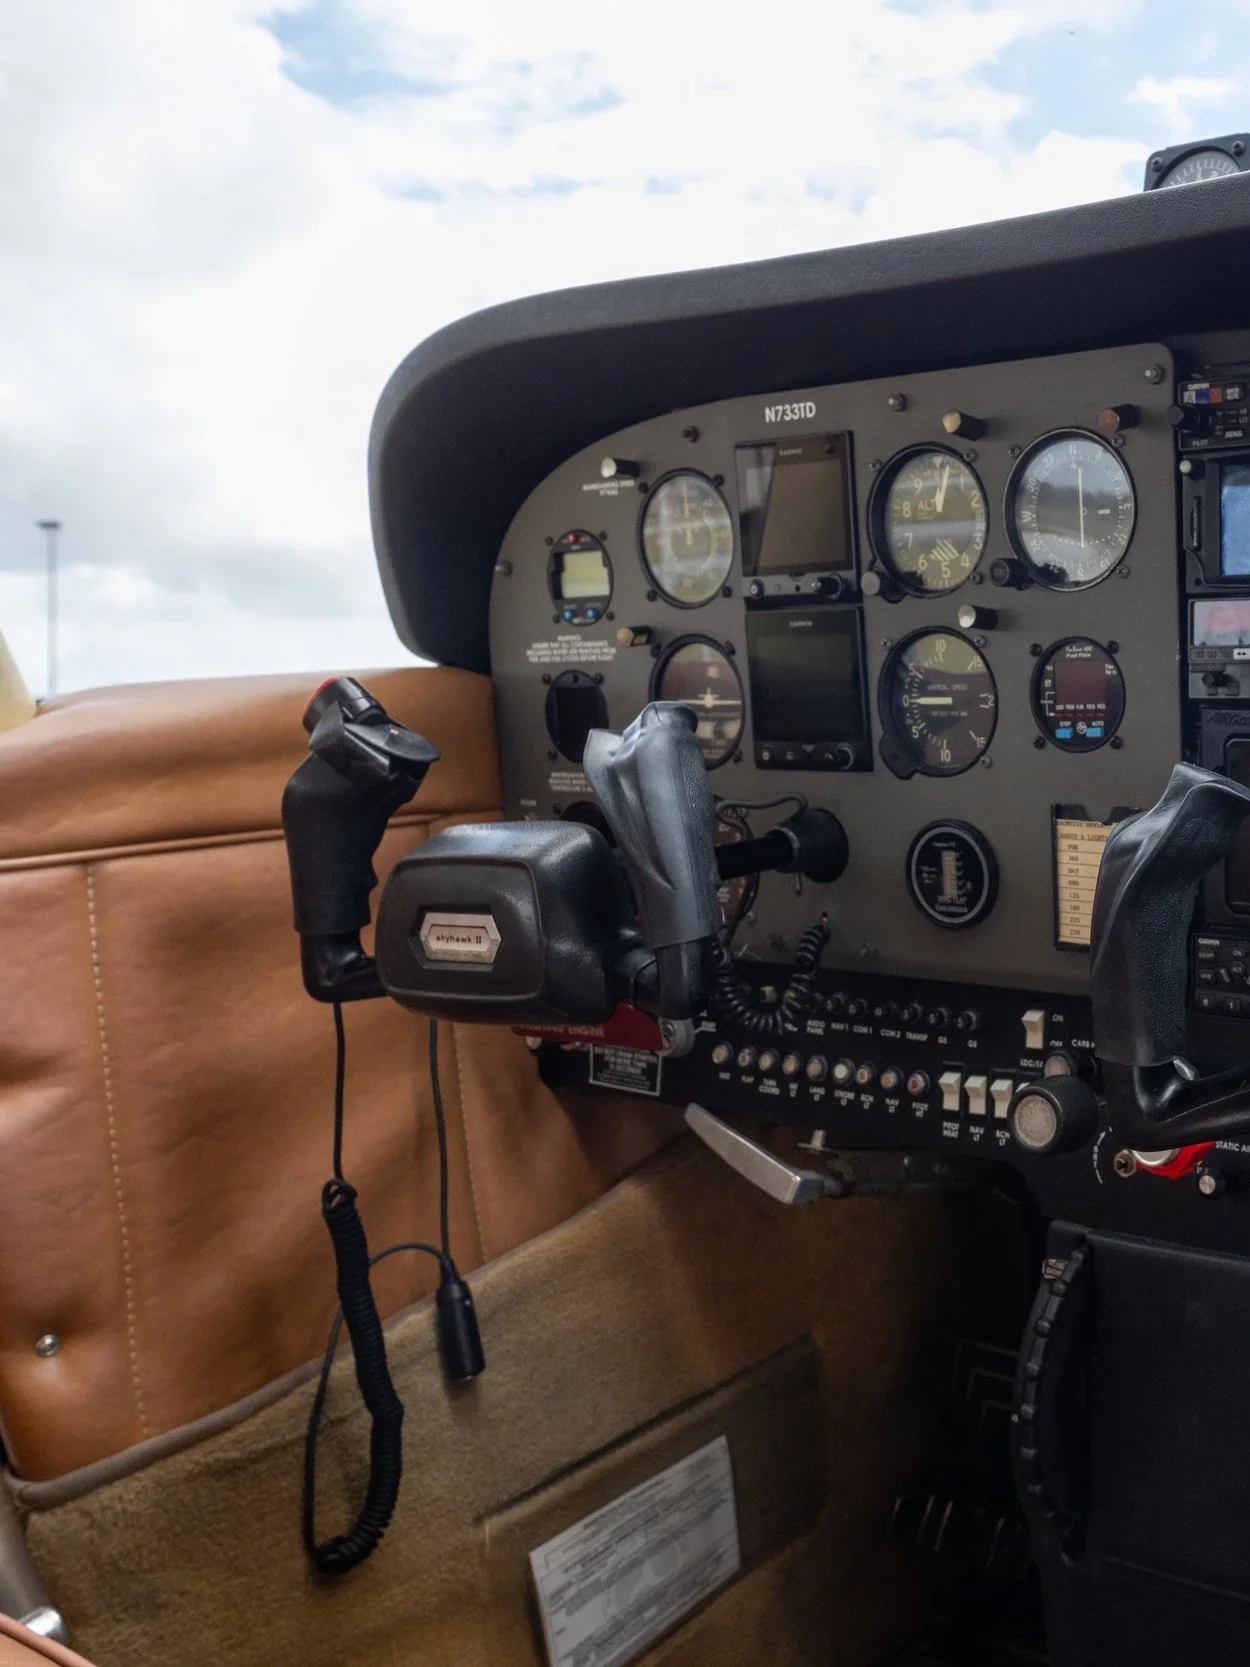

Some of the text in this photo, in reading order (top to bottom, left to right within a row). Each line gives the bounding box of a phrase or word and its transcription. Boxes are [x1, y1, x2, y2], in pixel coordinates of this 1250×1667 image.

[764, 401, 816, 423] N733TD
[1224, 430, 1242, 438] SENS
[902, 501, 911, 518] 8
[918, 500, 936, 510] ALT
[918, 554, 928, 570] 6
[960, 552, 970, 569] 4
[941, 562, 950, 578] 5
[940, 750, 951, 762] 10
[436, 935, 472, 944] skyhawk
[1052, 1014, 1064, 1022] ON
[906, 1032, 928, 1041] TRANSP
[1072, 1039, 1090, 1048] CARB
[809, 1086, 825, 1094] LAND
[943, 1122, 960, 1130] PITOT
[970, 1126, 984, 1134] NAV
[943, 1129, 959, 1138] HEAT
[996, 1130, 1010, 1139] BCN
[1216, 1140, 1240, 1152] STATIC
